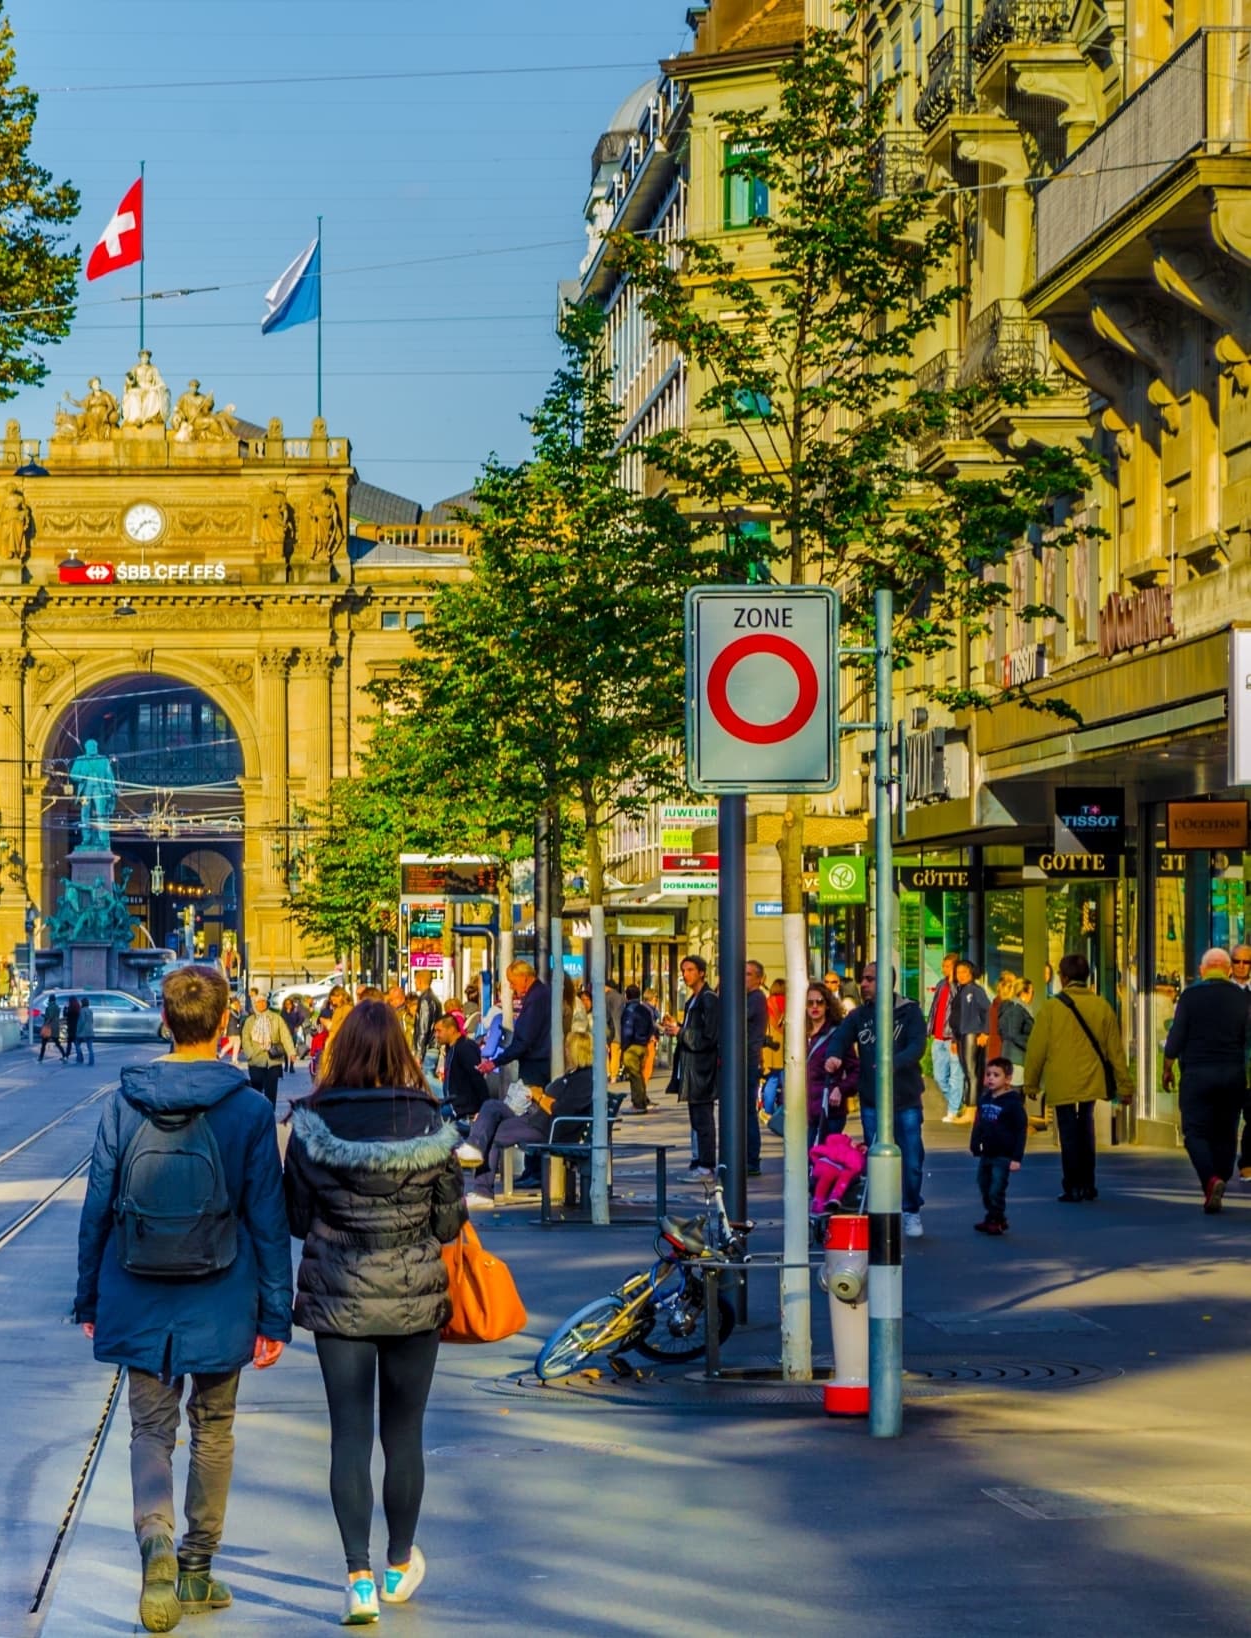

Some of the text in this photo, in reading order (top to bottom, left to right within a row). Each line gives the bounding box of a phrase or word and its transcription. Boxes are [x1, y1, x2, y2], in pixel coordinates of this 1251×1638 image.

[117, 564, 226, 580] SBB CFF FFS
[733, 607, 793, 629] ZONE
[1010, 642, 1038, 688] TISSOT
[664, 808, 718, 817] JUWELIER
[1061, 815, 1119, 827] TISSOT
[912, 869, 968, 887] GÖTTE
[416, 957, 426, 966] 17
